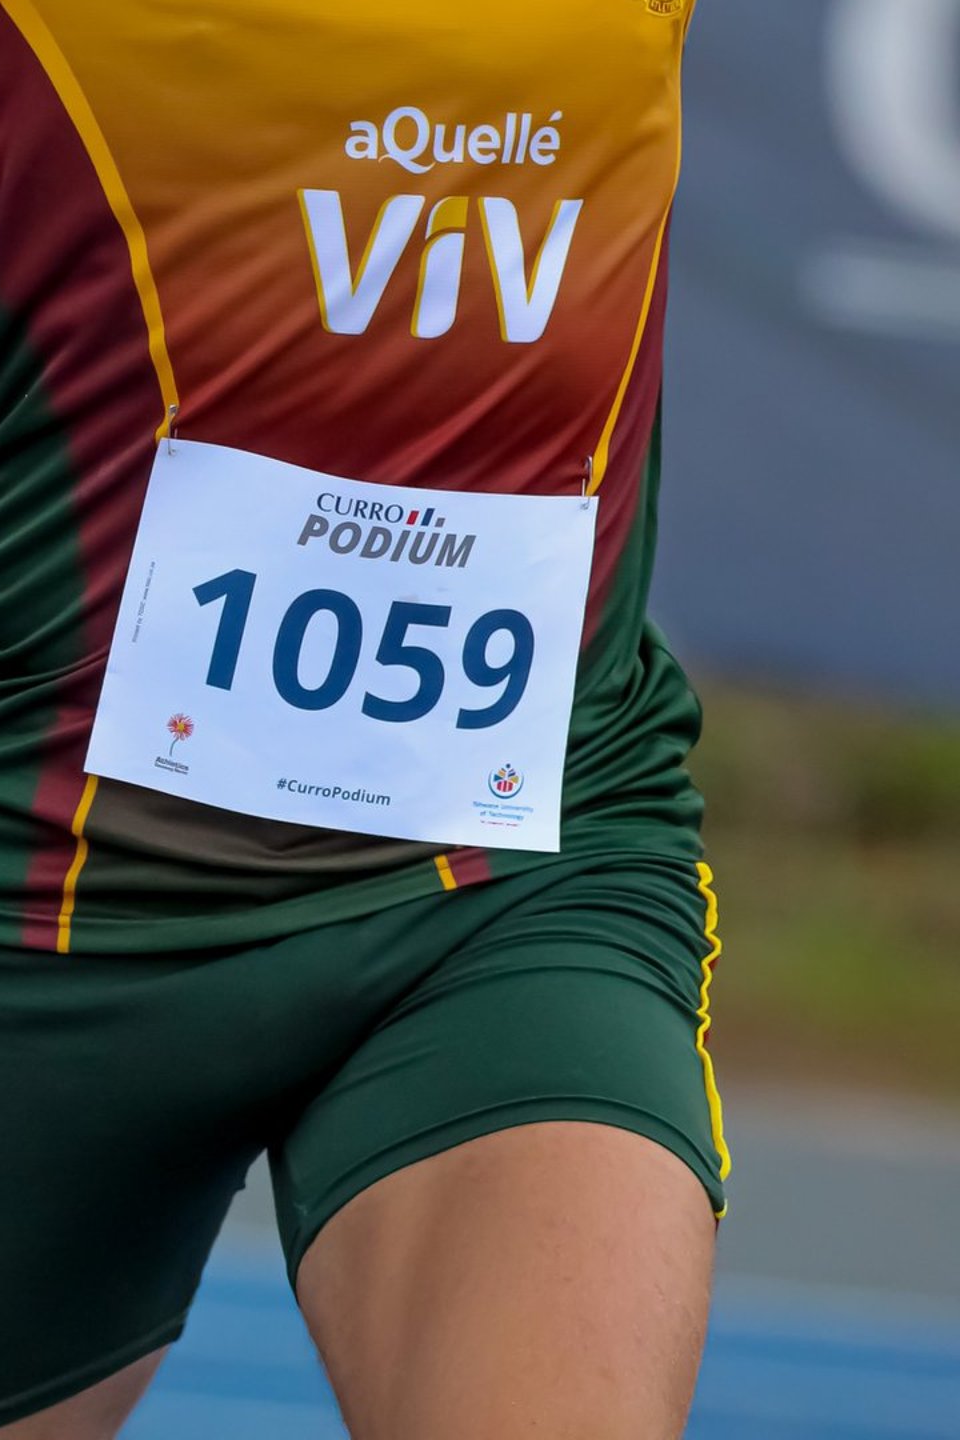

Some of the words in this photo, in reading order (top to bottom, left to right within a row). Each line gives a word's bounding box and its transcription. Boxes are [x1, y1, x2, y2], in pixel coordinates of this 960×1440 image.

[344, 106, 563, 174] aQuellé
[316, 492, 404, 523] CURRO
[297, 514, 477, 568] PODIUM
[192, 568, 535, 730] 1059
[277, 778, 391, 806] #CurroPodium
